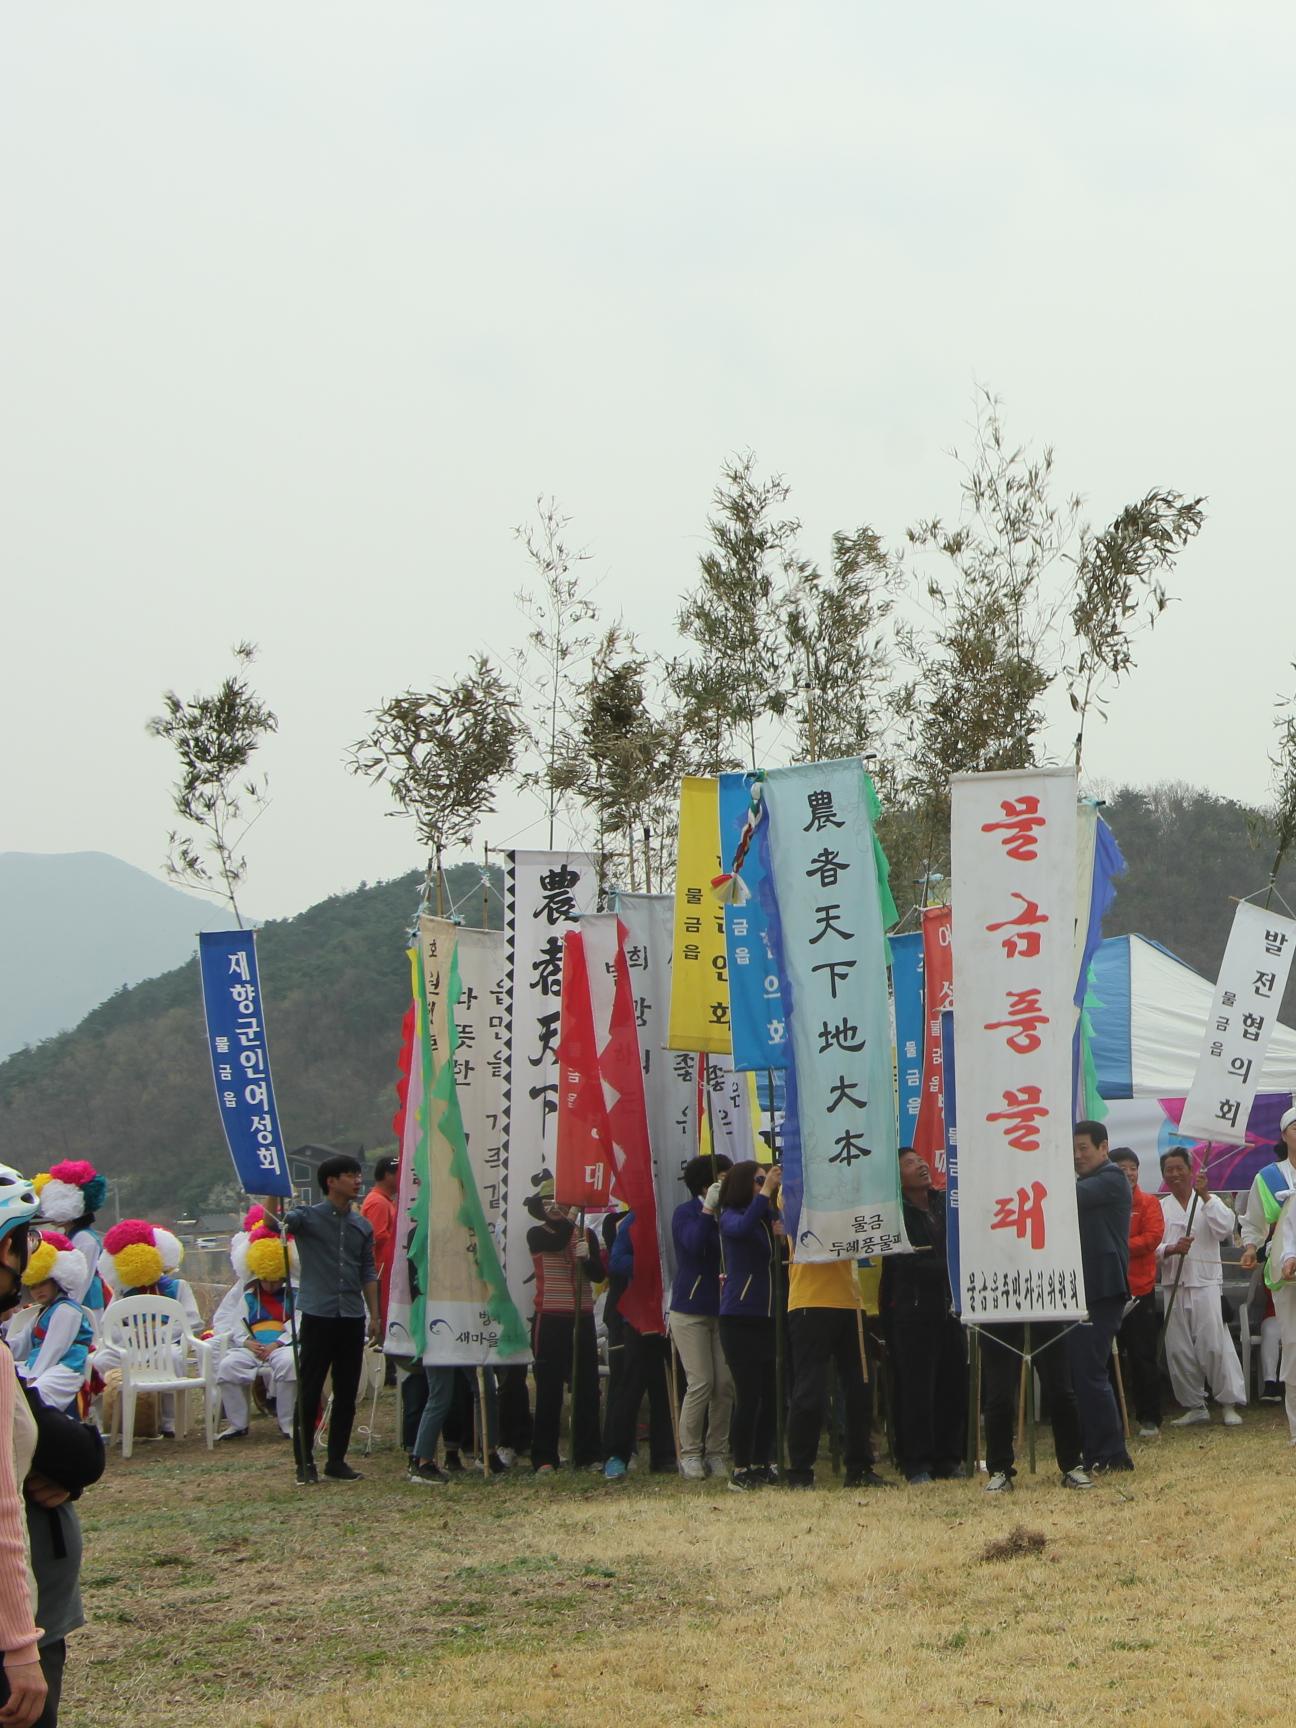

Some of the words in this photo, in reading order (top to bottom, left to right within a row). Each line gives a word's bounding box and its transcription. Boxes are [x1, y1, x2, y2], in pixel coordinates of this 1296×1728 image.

[682, 887, 703, 961] 물금읍
[731, 899, 751, 965] 금읍
[1209, 991, 1237, 1057] 물금읍
[1214, 928, 1289, 1128] 발전협의회
[214, 1036, 237, 1108] 물금읍
[227, 951, 281, 1175] 재향군인여성회
[904, 1041, 920, 1115] 물금읍
[851, 1213, 884, 1233] 물금
